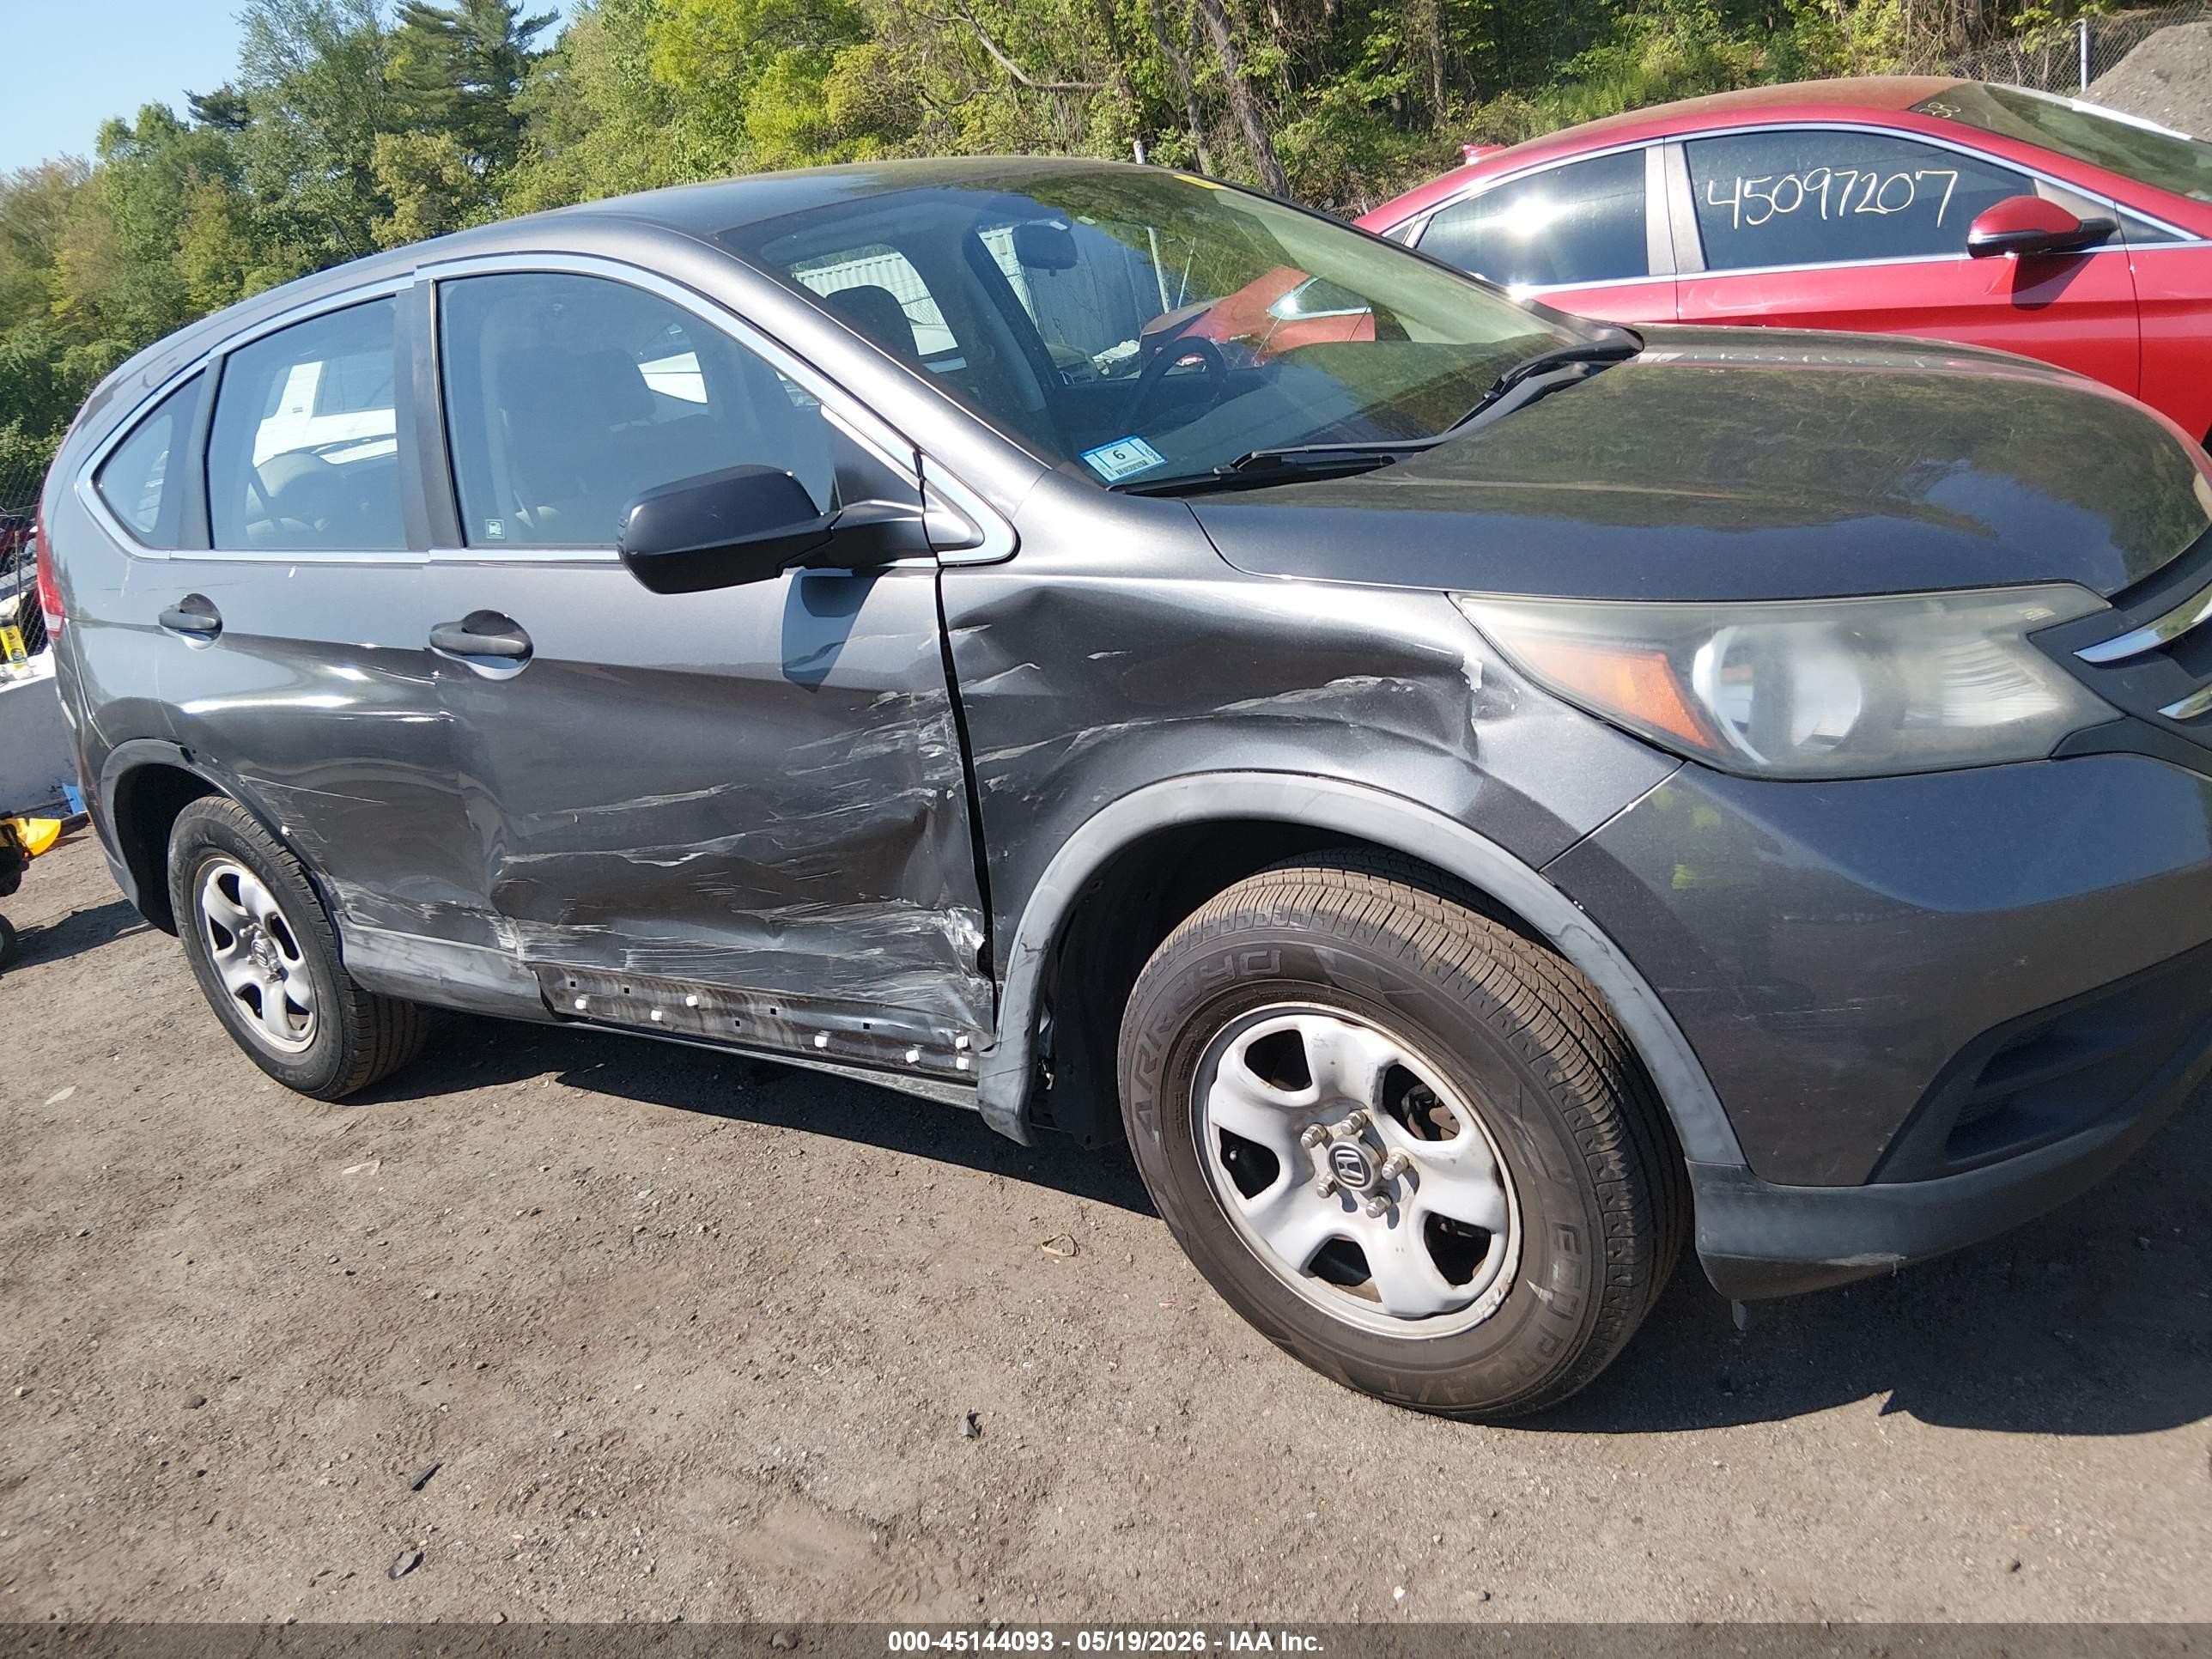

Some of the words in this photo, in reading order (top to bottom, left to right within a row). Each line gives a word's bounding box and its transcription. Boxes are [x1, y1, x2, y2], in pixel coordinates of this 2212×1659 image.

[1708, 167, 1959, 229] 45097207
[1112, 449, 1127, 460] 6
[1133, 948, 1282, 1142] ARROYO
